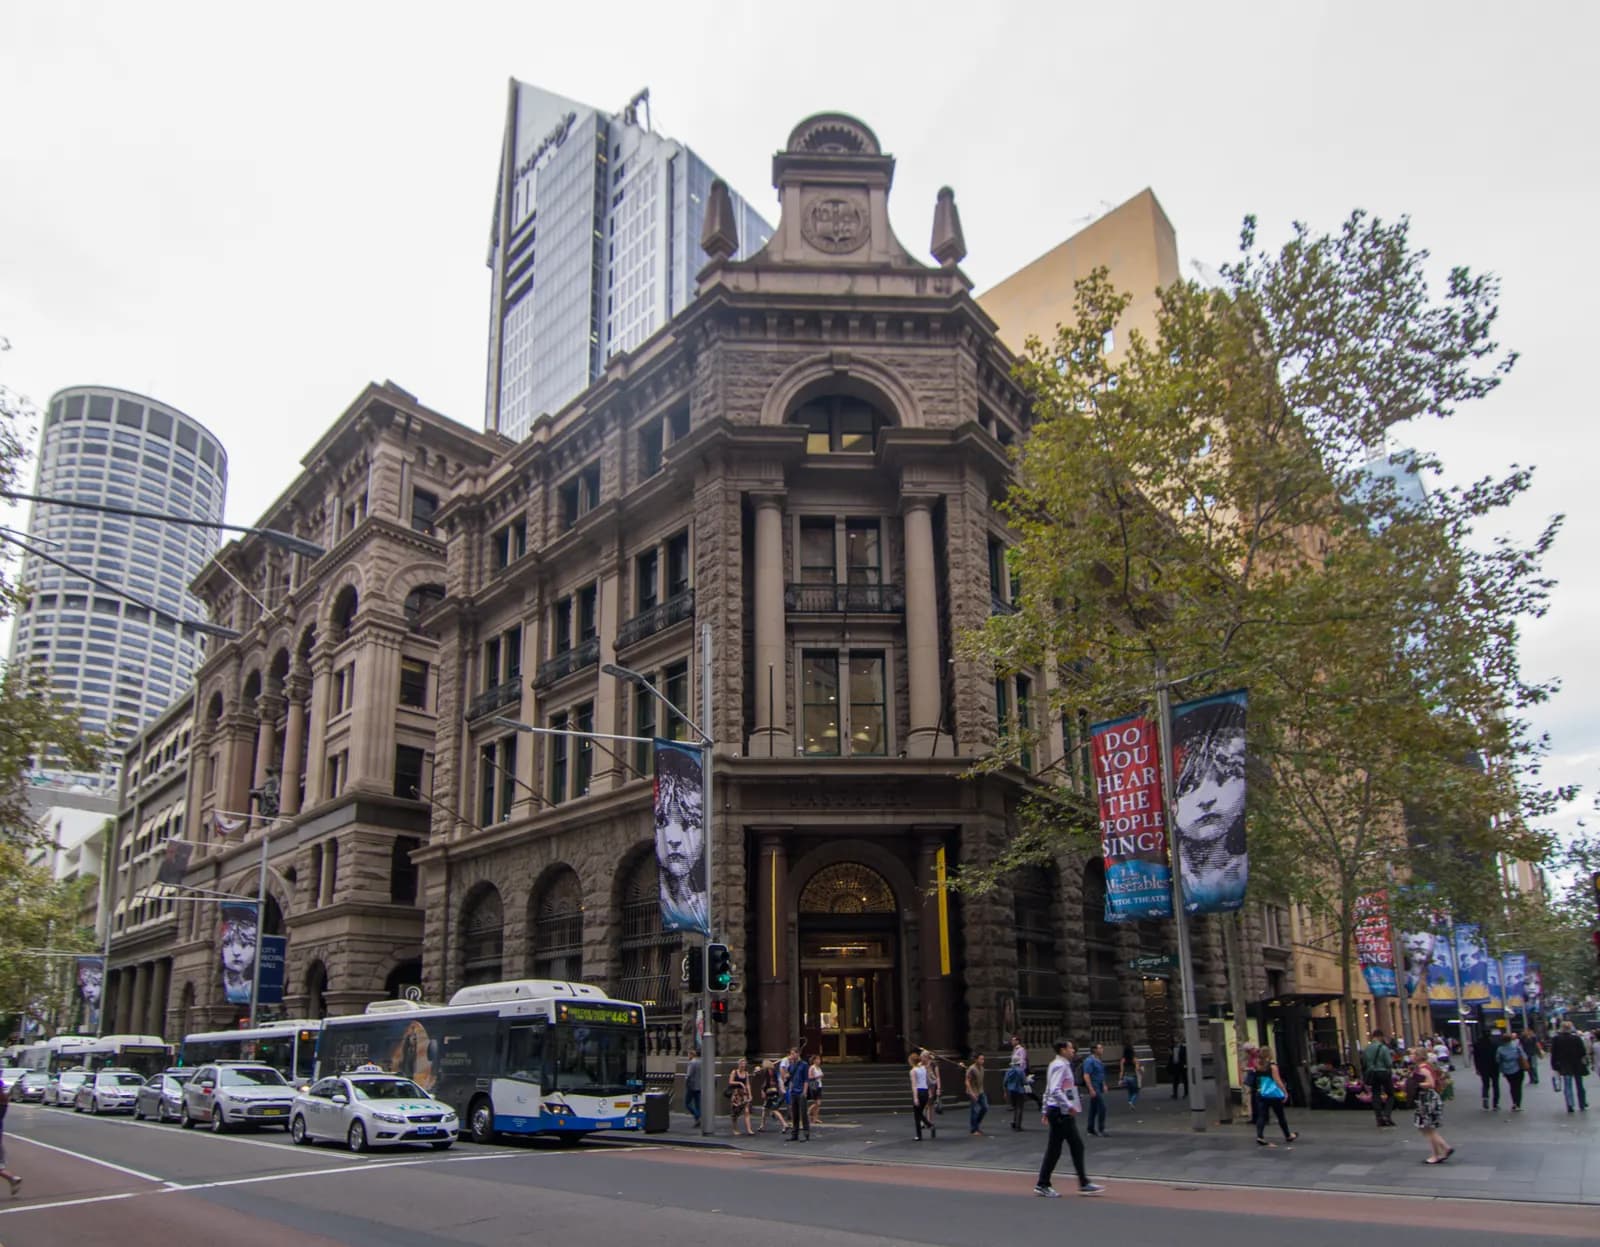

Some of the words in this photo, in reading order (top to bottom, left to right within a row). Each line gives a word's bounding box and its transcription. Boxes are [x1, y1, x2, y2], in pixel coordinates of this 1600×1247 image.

[1105, 727, 1140, 750] DO
[1100, 745, 1149, 772] YOU
[1097, 767, 1155, 794] HEAR
[1105, 790, 1150, 815] THE
[1102, 832, 1164, 857] SING?
